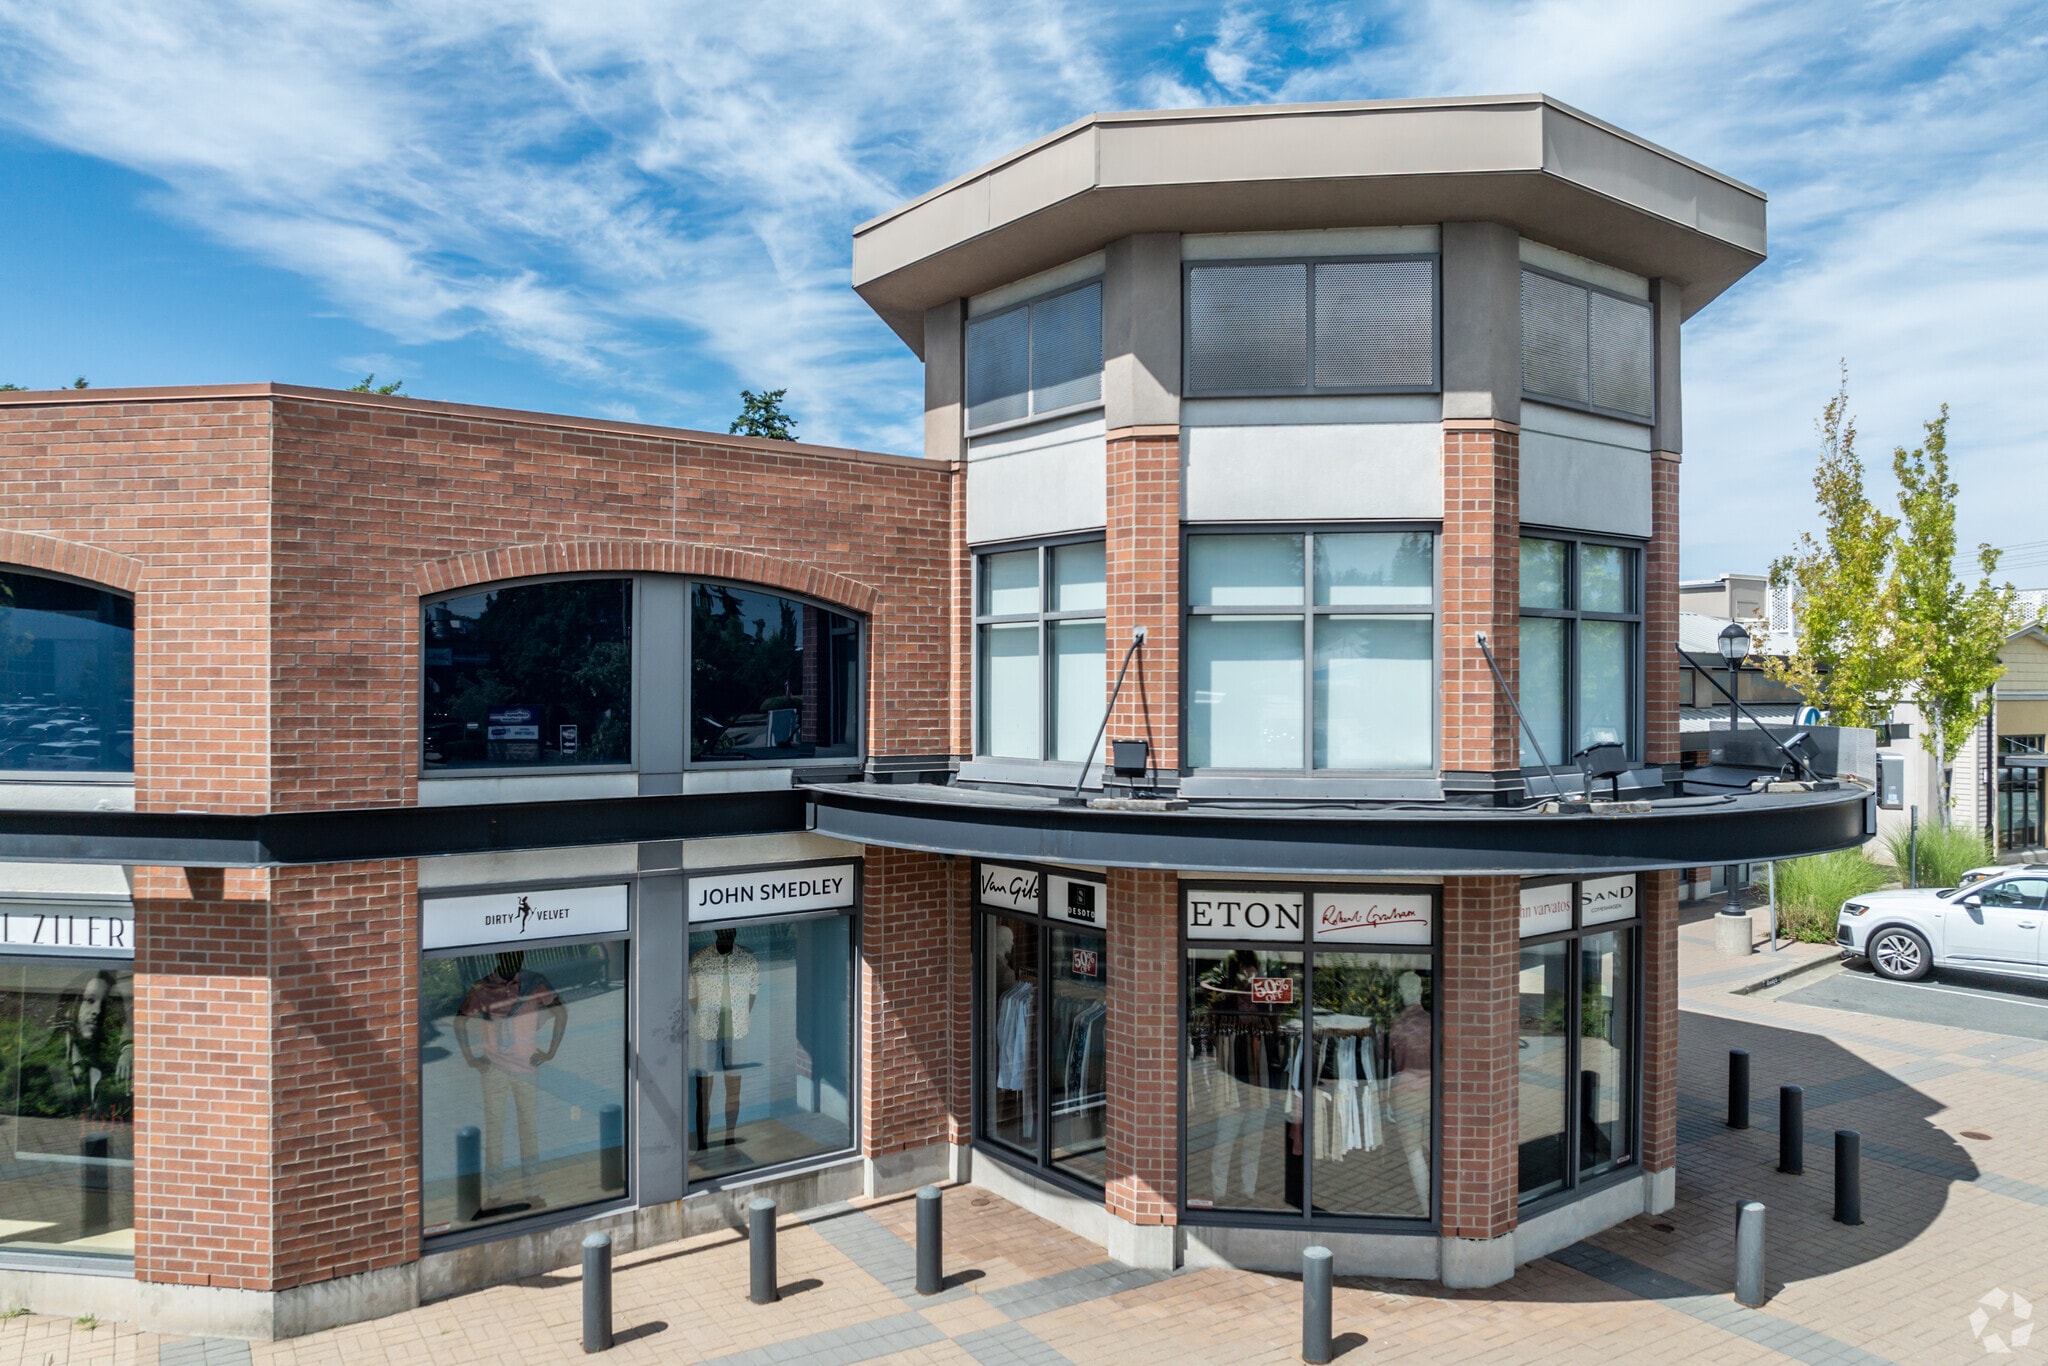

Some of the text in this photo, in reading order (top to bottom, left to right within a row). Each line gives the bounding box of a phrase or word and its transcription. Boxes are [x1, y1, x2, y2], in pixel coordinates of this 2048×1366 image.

[699, 877, 843, 907] JOHN SMEDLEY
[981, 871, 1039, 906] Van Gils
[1581, 885, 1634, 906] SAND
[485, 908, 570, 926] DIRTY VELVET
[1068, 906, 1096, 919] DESOTO
[1190, 901, 1303, 929] ETON
[1533, 900, 1571, 916] varvatos
[33, 913, 124, 947] ZILER
[1074, 951, 1095, 968] 50%
[1253, 979, 1289, 998] 50%
[1265, 991, 1283, 1003] OFF
